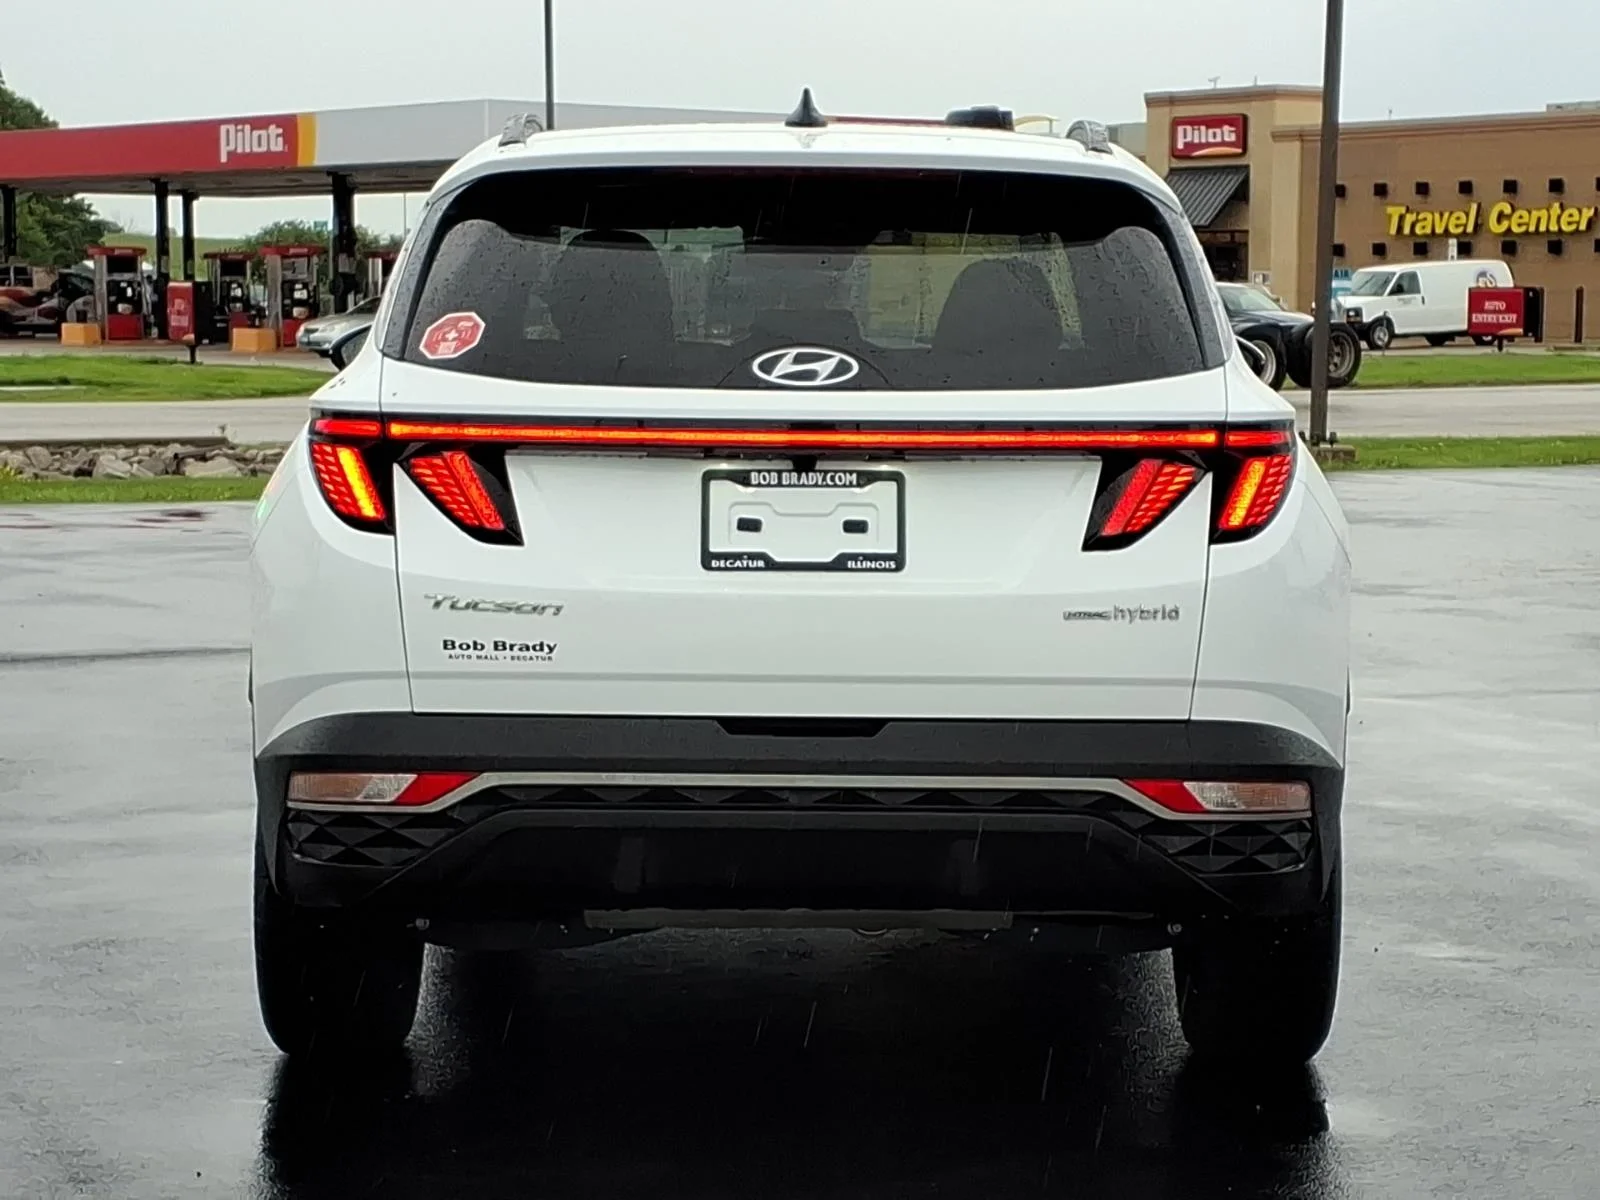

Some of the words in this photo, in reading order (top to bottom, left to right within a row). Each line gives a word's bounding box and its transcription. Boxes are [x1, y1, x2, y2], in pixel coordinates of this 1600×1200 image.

[1386, 203, 1477, 235] Travel
[1488, 201, 1594, 234] Center
[751, 472, 778, 485] BOB
[782, 472, 857, 485] BRADY.COM
[711, 559, 765, 568] DECATUR
[847, 560, 896, 569] ILLINOIS
[1114, 604, 1180, 624] hybrid
[442, 639, 486, 651] Bob
[493, 640, 558, 654] Brady
